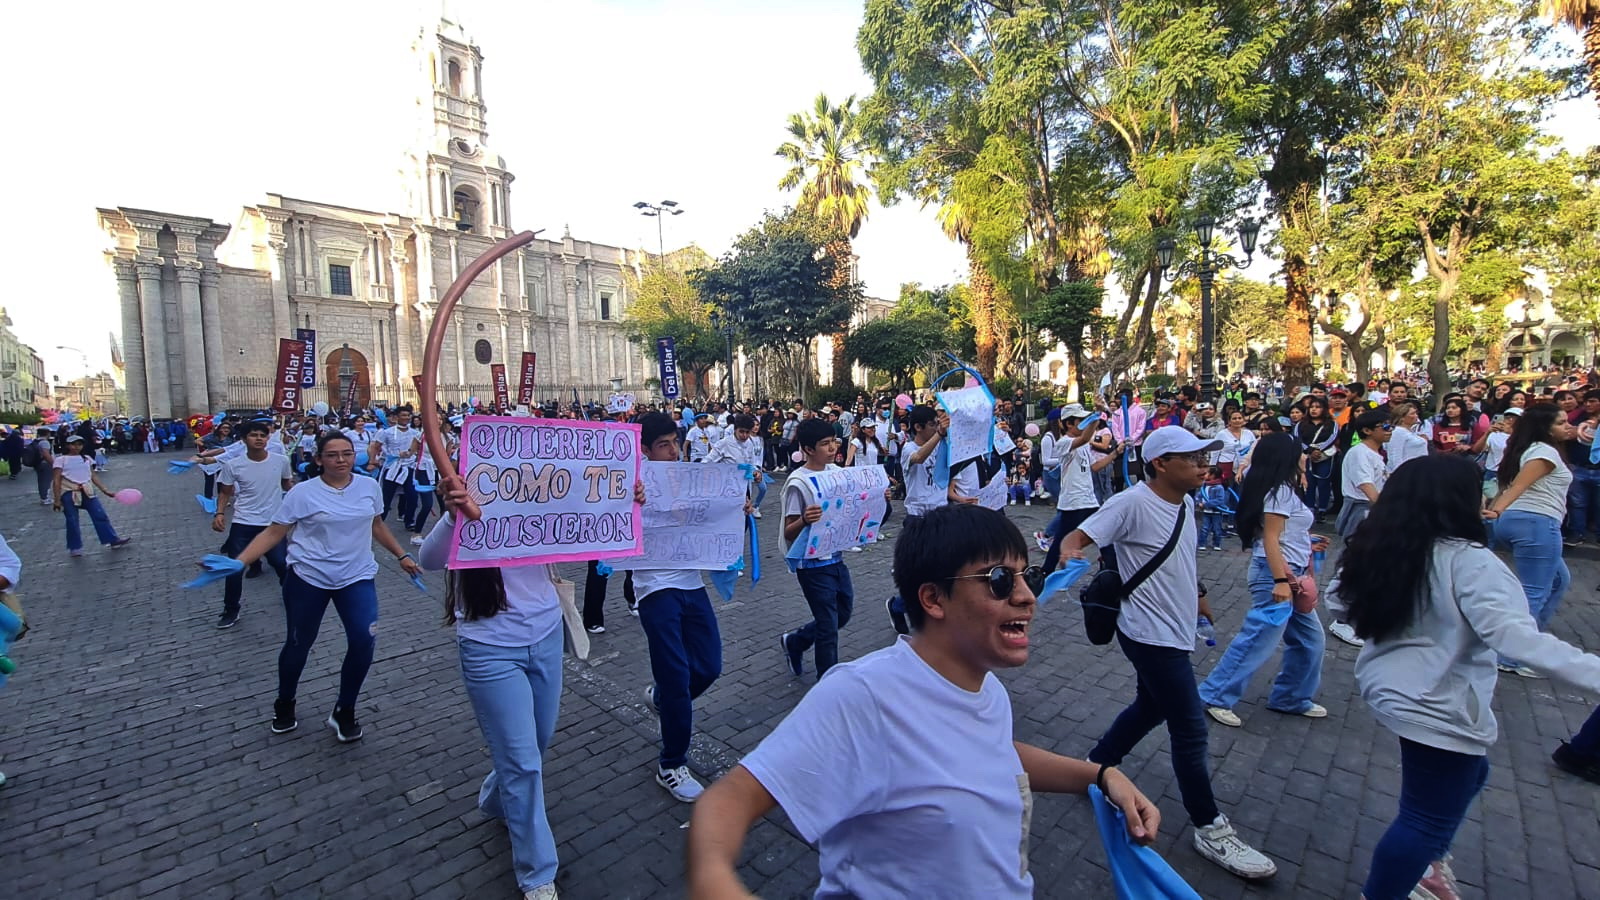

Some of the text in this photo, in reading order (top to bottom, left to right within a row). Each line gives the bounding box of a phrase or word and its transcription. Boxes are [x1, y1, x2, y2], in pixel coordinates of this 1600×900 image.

[281, 353, 300, 409] Del Pilar
[303, 340, 313, 384] Del Pilar
[522, 362, 534, 404] Del Pilar
[664, 348, 676, 394] Del Pilar
[497, 372, 508, 409] Del Pilar
[466, 463, 627, 505] COMO TE
[459, 512, 634, 550] QUISIERON
